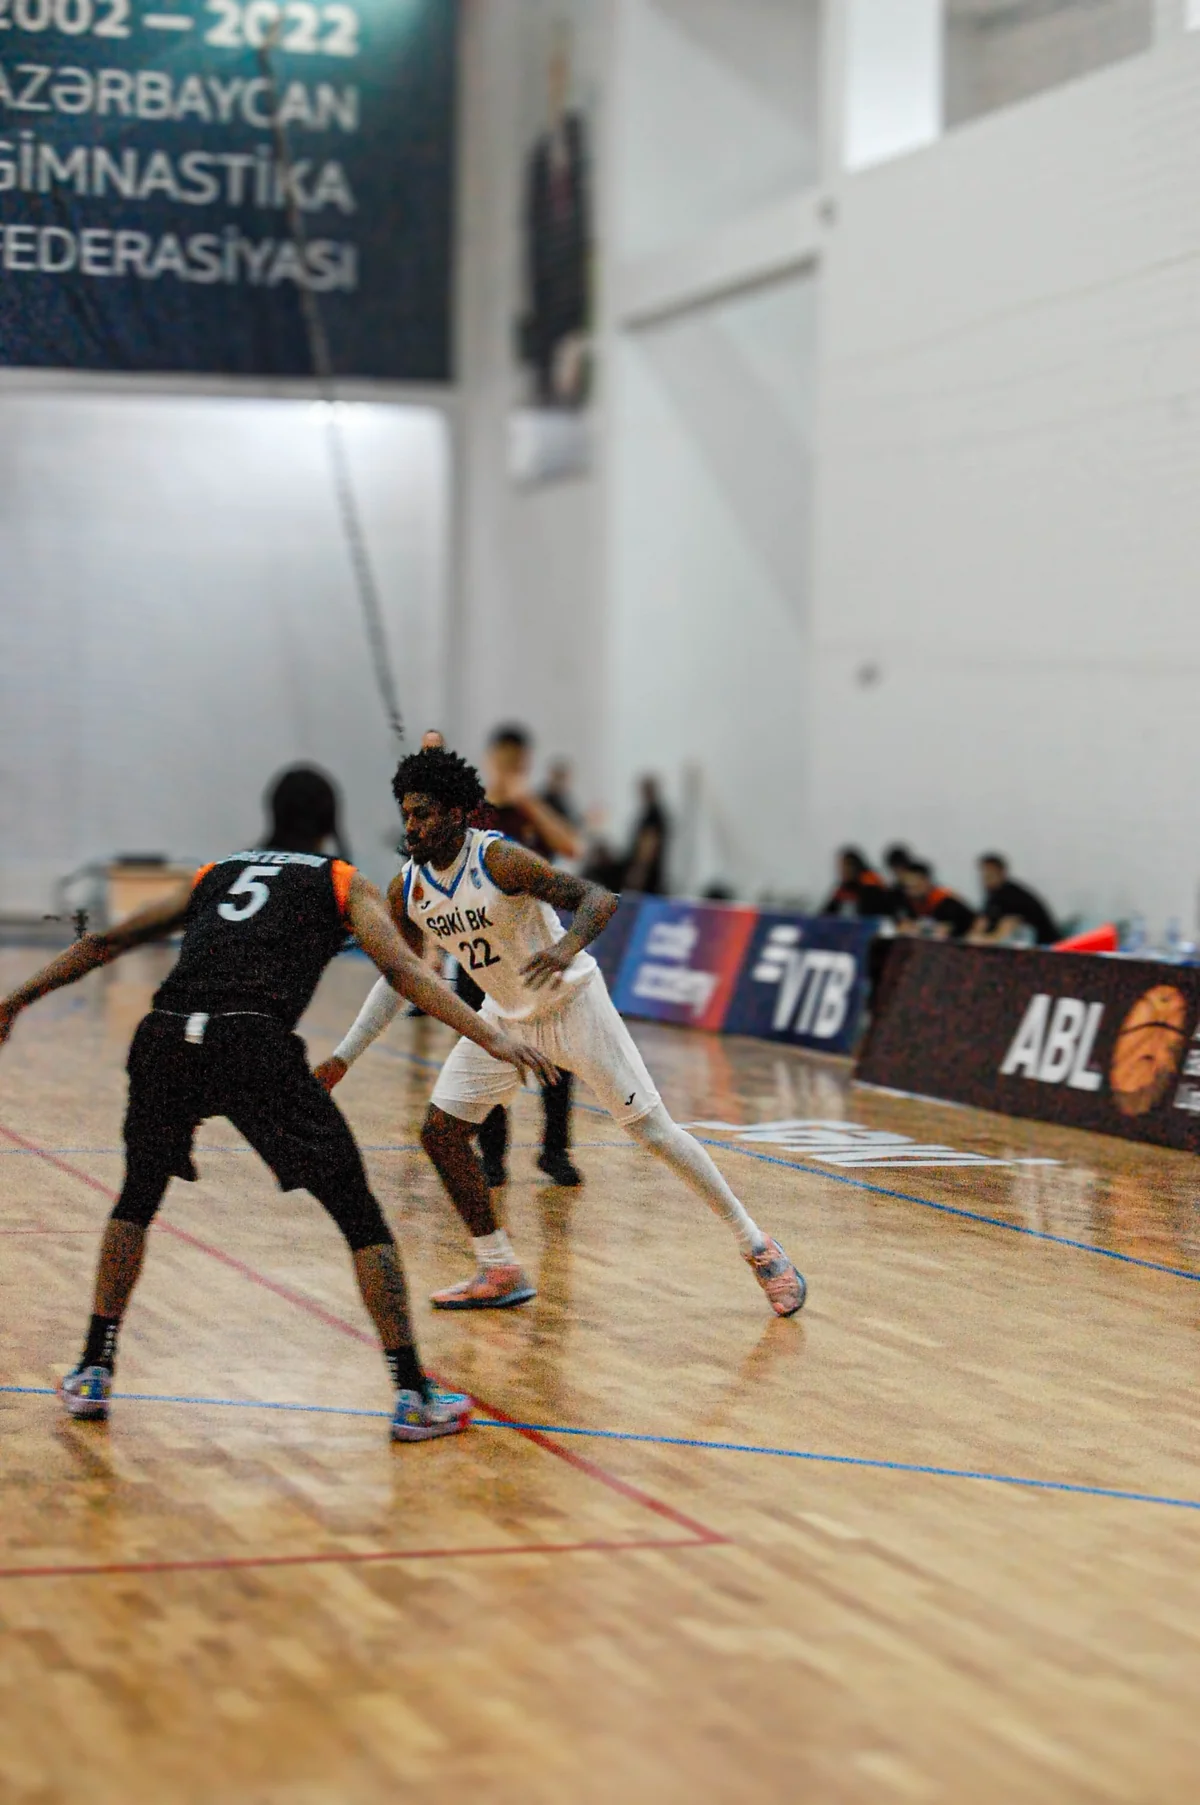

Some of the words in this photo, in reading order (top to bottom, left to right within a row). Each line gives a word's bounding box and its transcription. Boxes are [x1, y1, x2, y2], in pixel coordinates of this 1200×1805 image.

[0, 0, 130, 38] 002
[204, 0, 359, 56] 2022
[0, 224, 358, 291] EDERASİYASI
[217, 865, 283, 922] 5
[465, 906, 495, 932] BK
[458, 936, 501, 970] 22
[1001, 993, 1105, 1091] ABL
